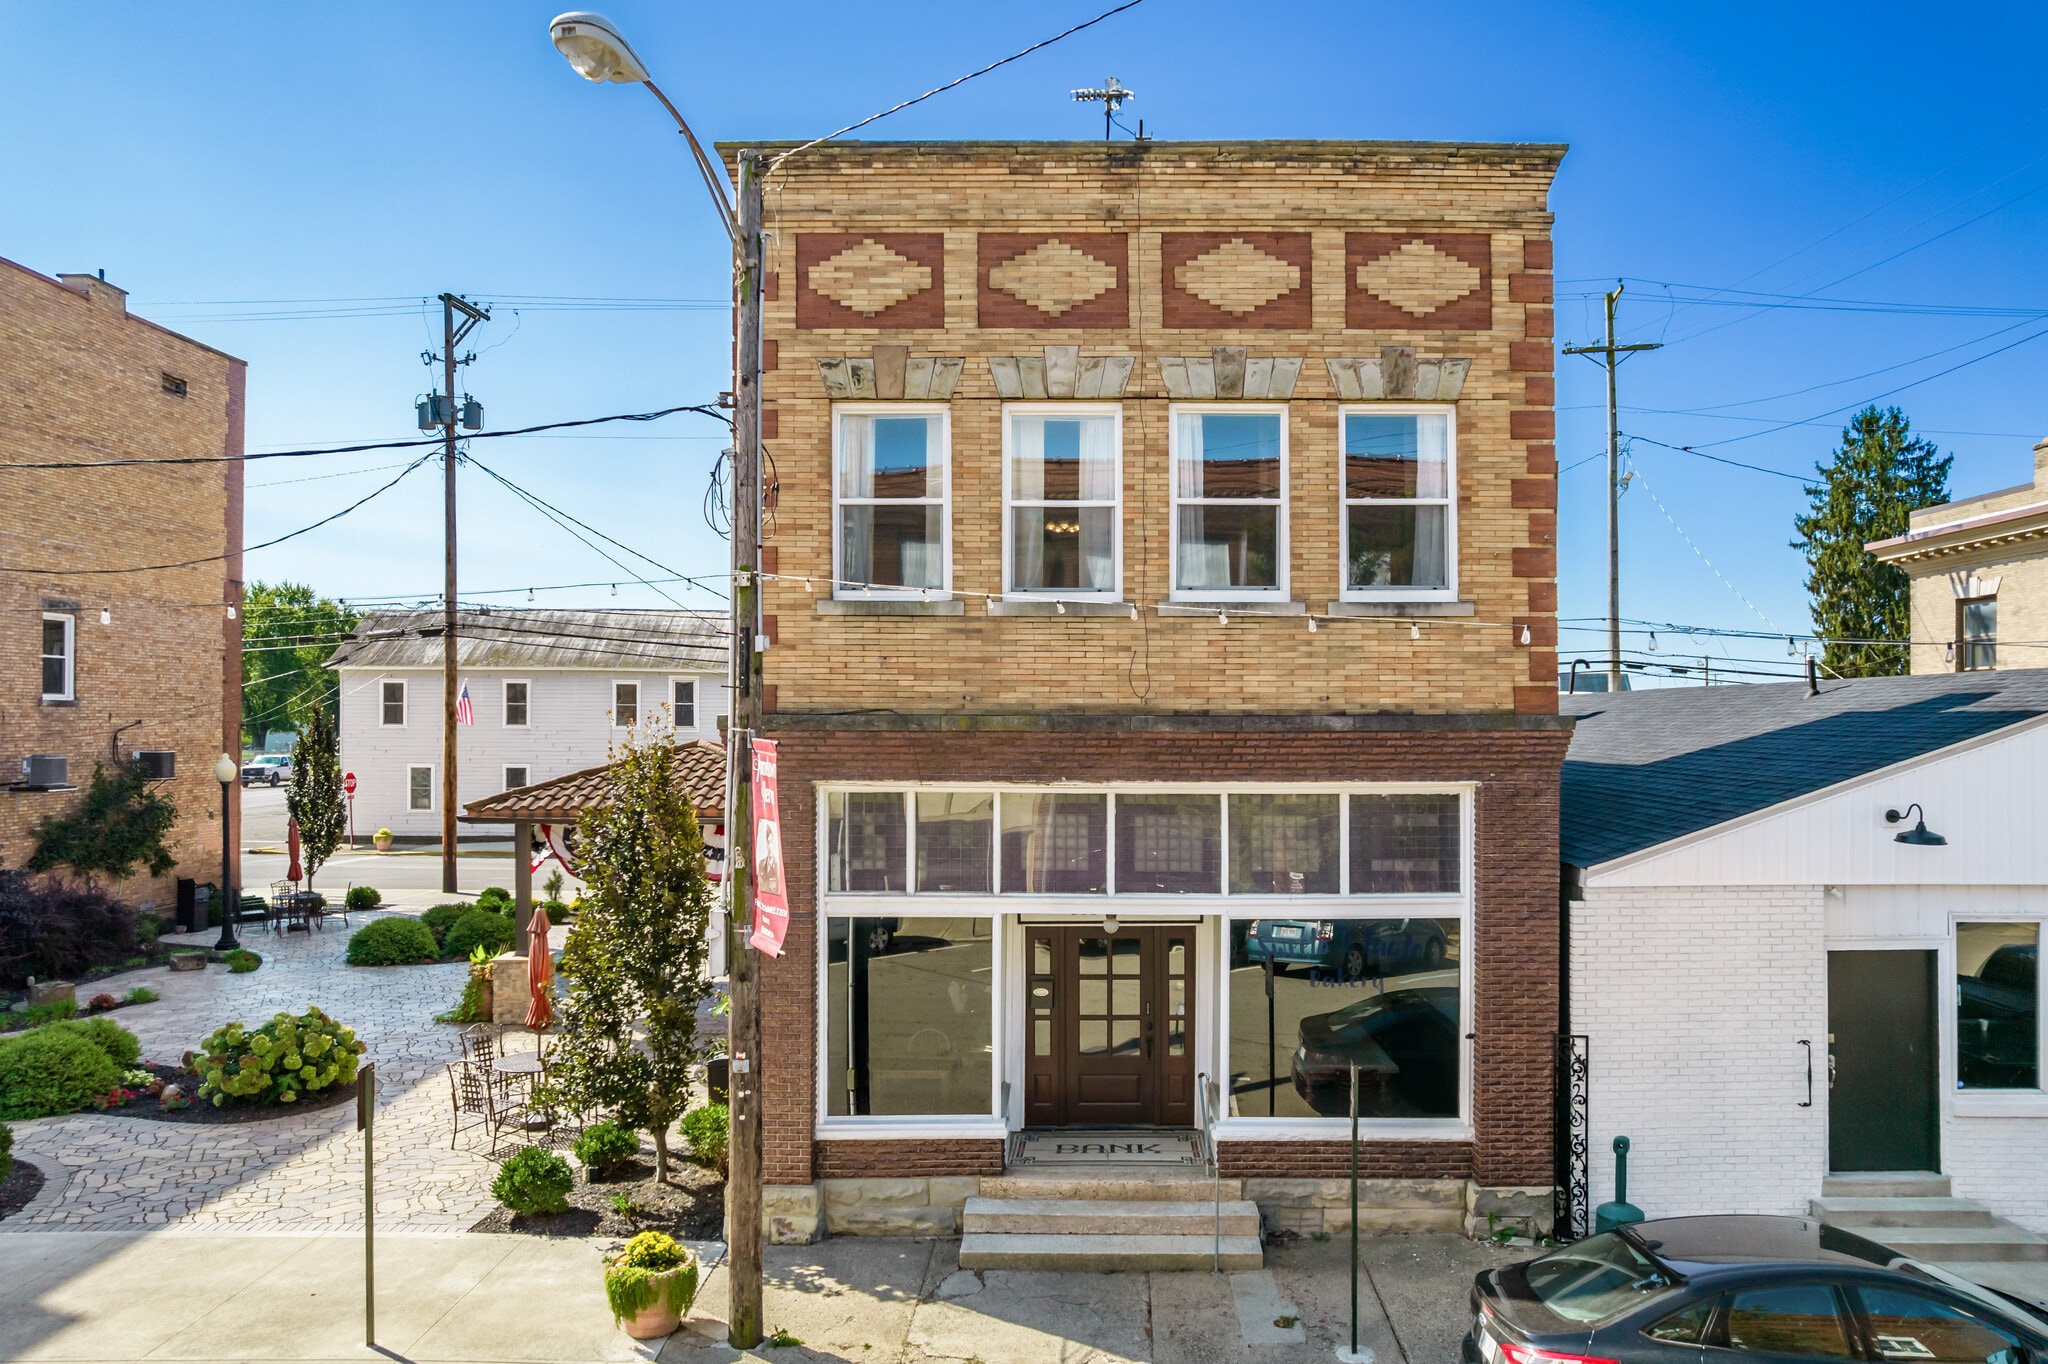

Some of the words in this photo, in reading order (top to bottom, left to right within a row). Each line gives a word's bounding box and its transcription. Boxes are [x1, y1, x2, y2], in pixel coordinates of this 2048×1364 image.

[344, 779, 356, 787] STOP
[1309, 969, 1385, 996] Bakery
[1055, 1143, 1161, 1154] BANK
